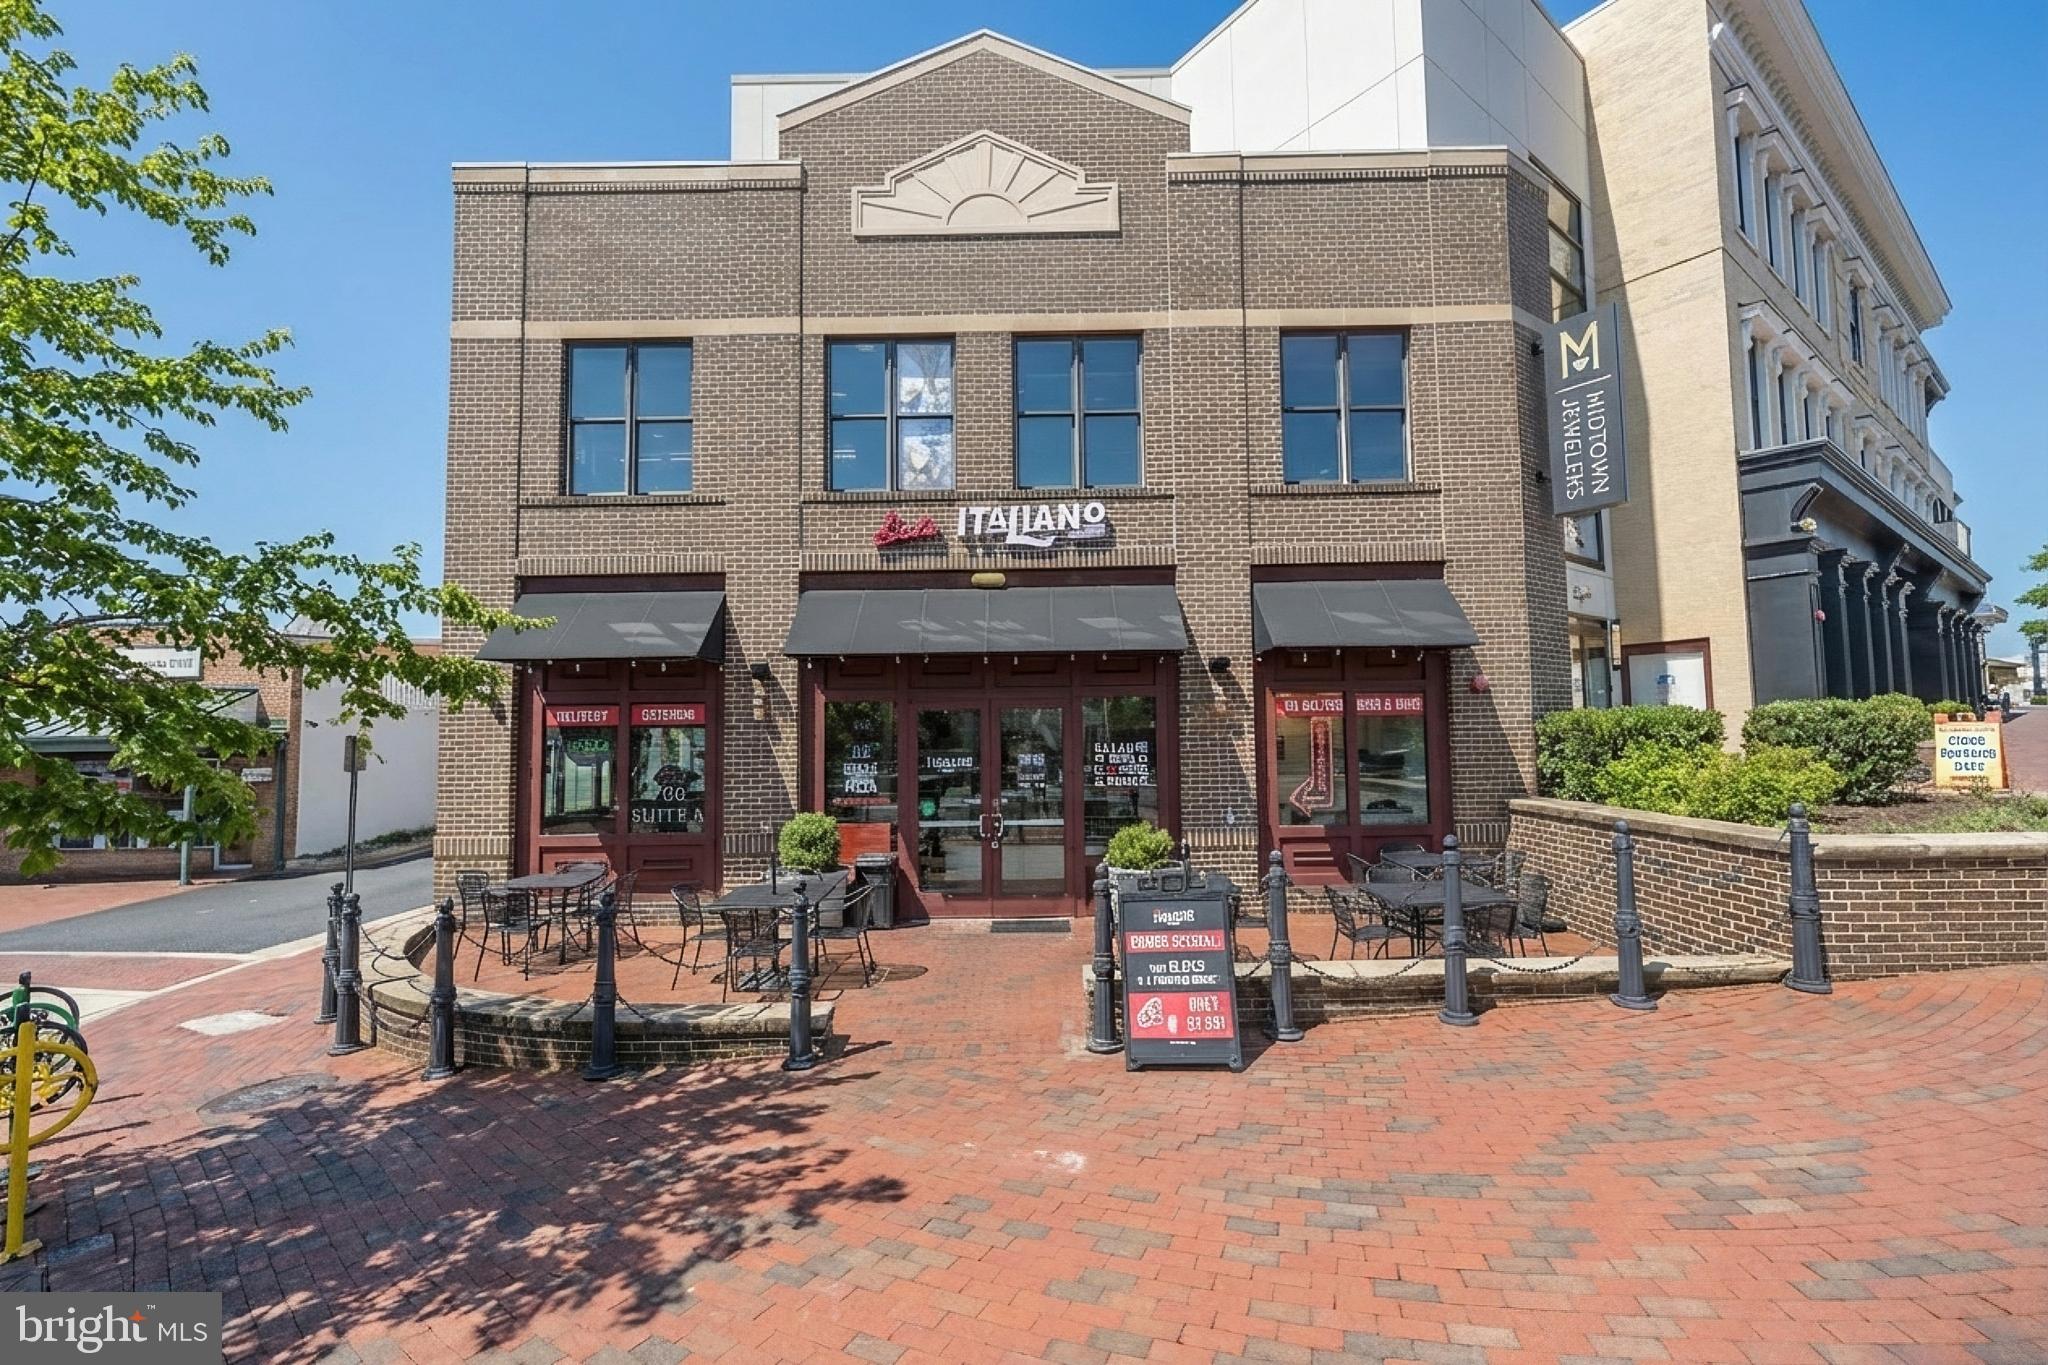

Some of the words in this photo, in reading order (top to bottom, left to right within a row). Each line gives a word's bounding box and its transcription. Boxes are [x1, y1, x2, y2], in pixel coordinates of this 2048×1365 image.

[1586, 390, 1610, 495] MIDTOWN
[957, 502, 1106, 547] ITALIANO
[631, 808, 687, 823] SUITE
